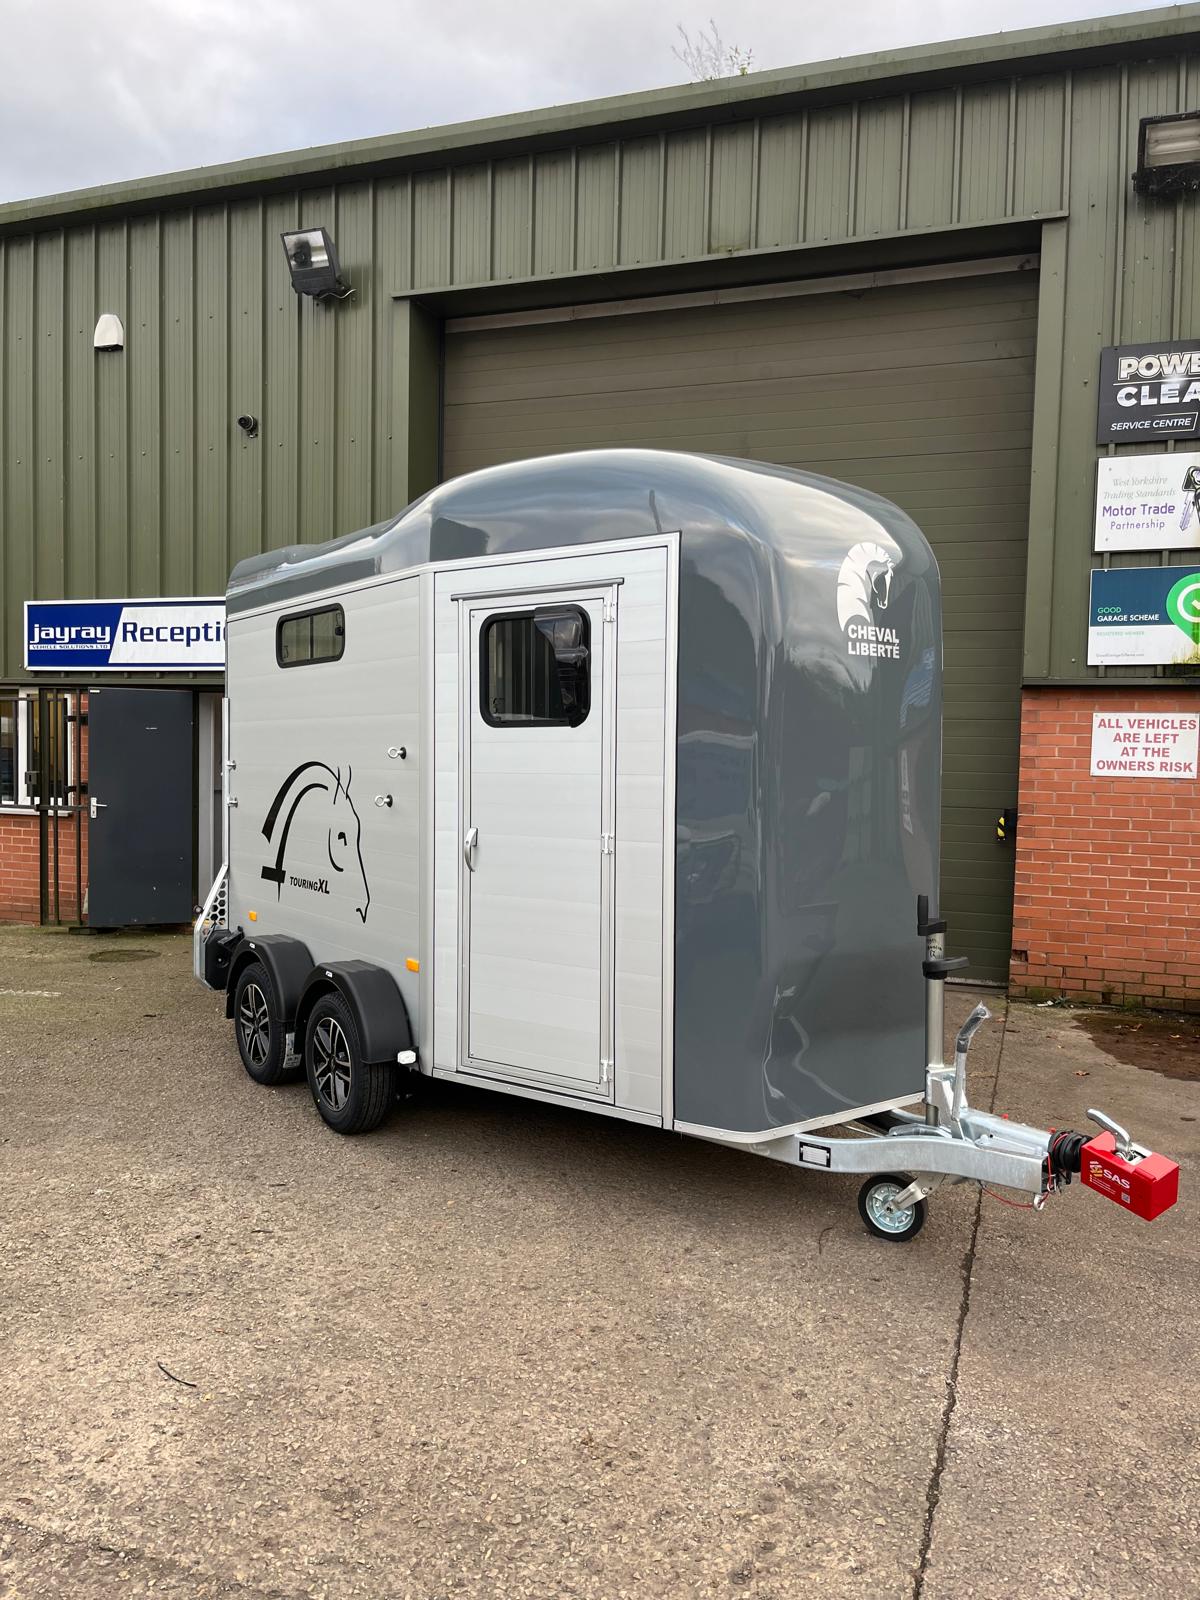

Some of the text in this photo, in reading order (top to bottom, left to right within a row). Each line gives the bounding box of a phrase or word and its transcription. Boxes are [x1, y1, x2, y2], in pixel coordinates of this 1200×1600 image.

[1117, 382, 1200, 407] CLEA
[1110, 418, 1192, 431] SERVICE CENTRE
[1113, 478, 1130, 487] West
[1104, 488, 1176, 500] Trading Standards
[1102, 502, 1176, 517] Motor Trade
[1110, 518, 1165, 531] Partnership
[1097, 614, 1128, 622] GARAGE
[29, 623, 111, 643] jayray
[122, 621, 226, 647] Recepti
[848, 624, 899, 643] CHEVAL
[848, 641, 900, 659] LIBERTÉ
[1098, 718, 1197, 730] ALL VEHICLES
[1113, 733, 1179, 743] ARE LEFT
[1121, 747, 1170, 757] AT THE
[1096, 760, 1193, 772] OWNERS RISK
[1103, 1169, 1130, 1189] SAS
